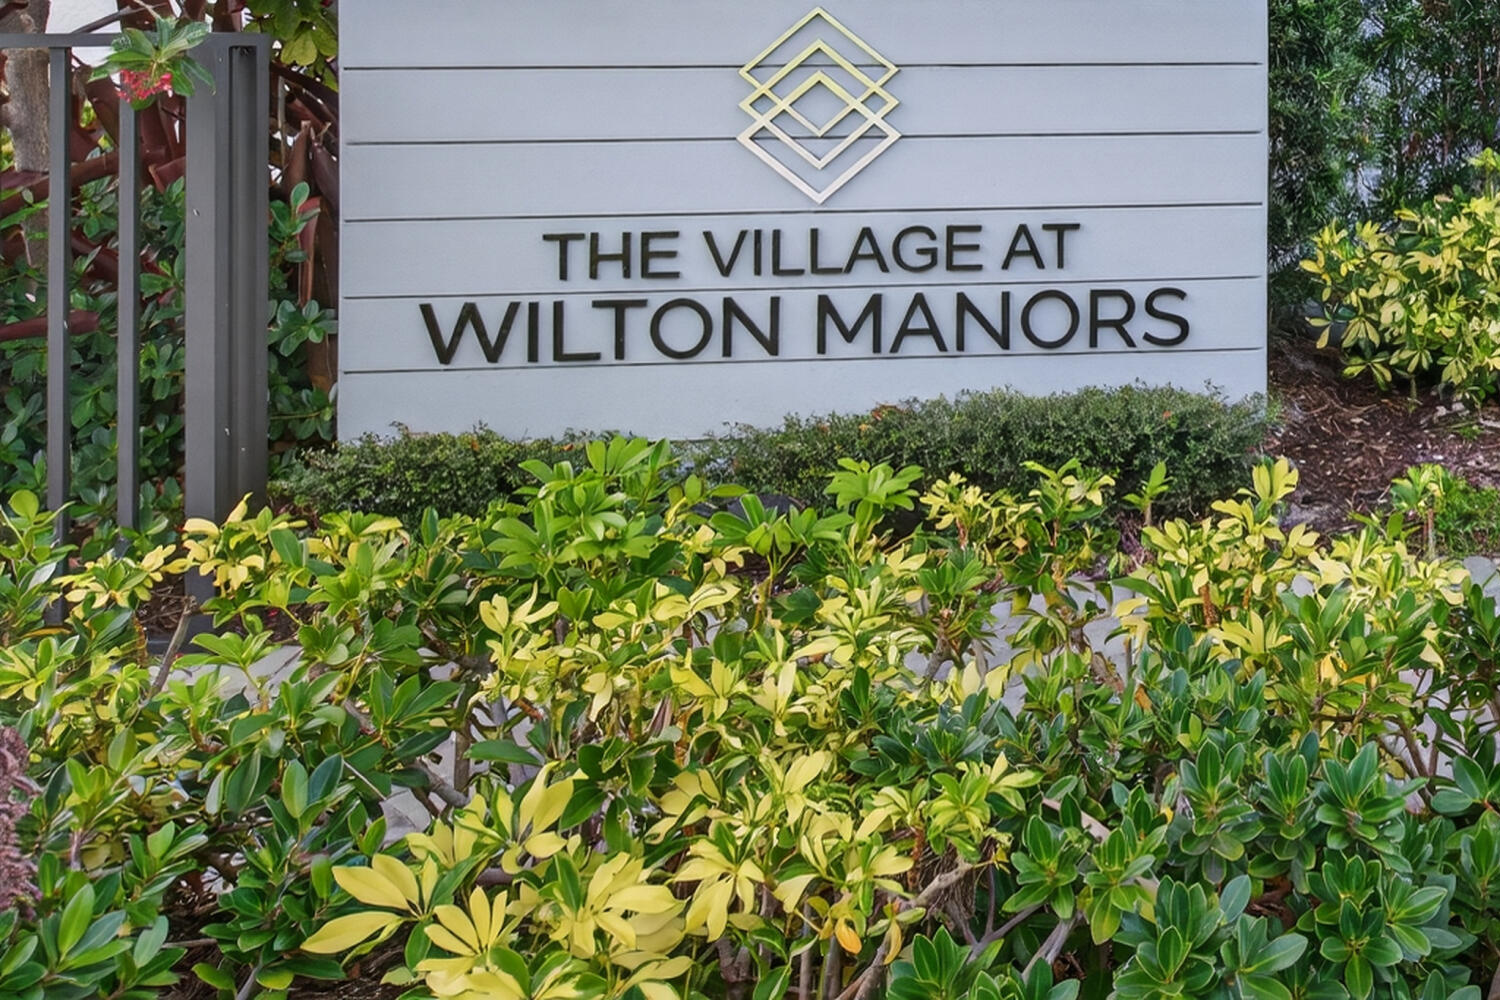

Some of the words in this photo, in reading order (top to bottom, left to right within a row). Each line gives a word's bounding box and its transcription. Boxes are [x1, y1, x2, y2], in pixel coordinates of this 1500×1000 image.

[542, 231, 681, 282] THE
[702, 225, 984, 278] VILLAGE
[1001, 222, 1081, 271] AT
[418, 296, 781, 366] WILTON
[816, 287, 1190, 354] MANORS
